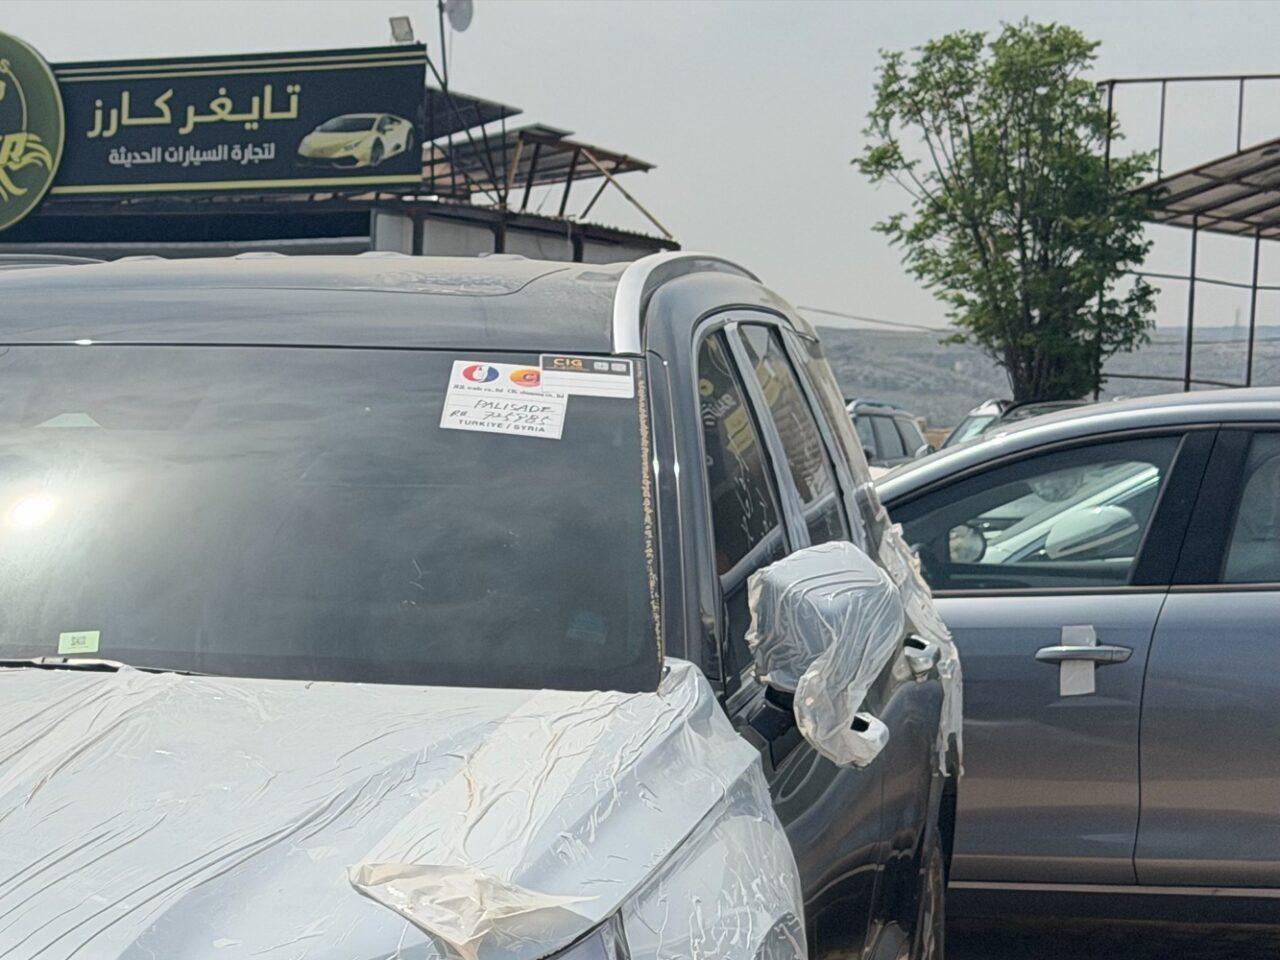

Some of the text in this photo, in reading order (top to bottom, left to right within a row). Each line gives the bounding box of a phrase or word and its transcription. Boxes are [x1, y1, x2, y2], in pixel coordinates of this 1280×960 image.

[86, 84, 302, 138] تايغر كارز
[108, 142, 276, 169] لتجارة السيارات الحديثة
[474, 399, 555, 413] PALISADE
[513, 424, 546, 433] SYRIA
